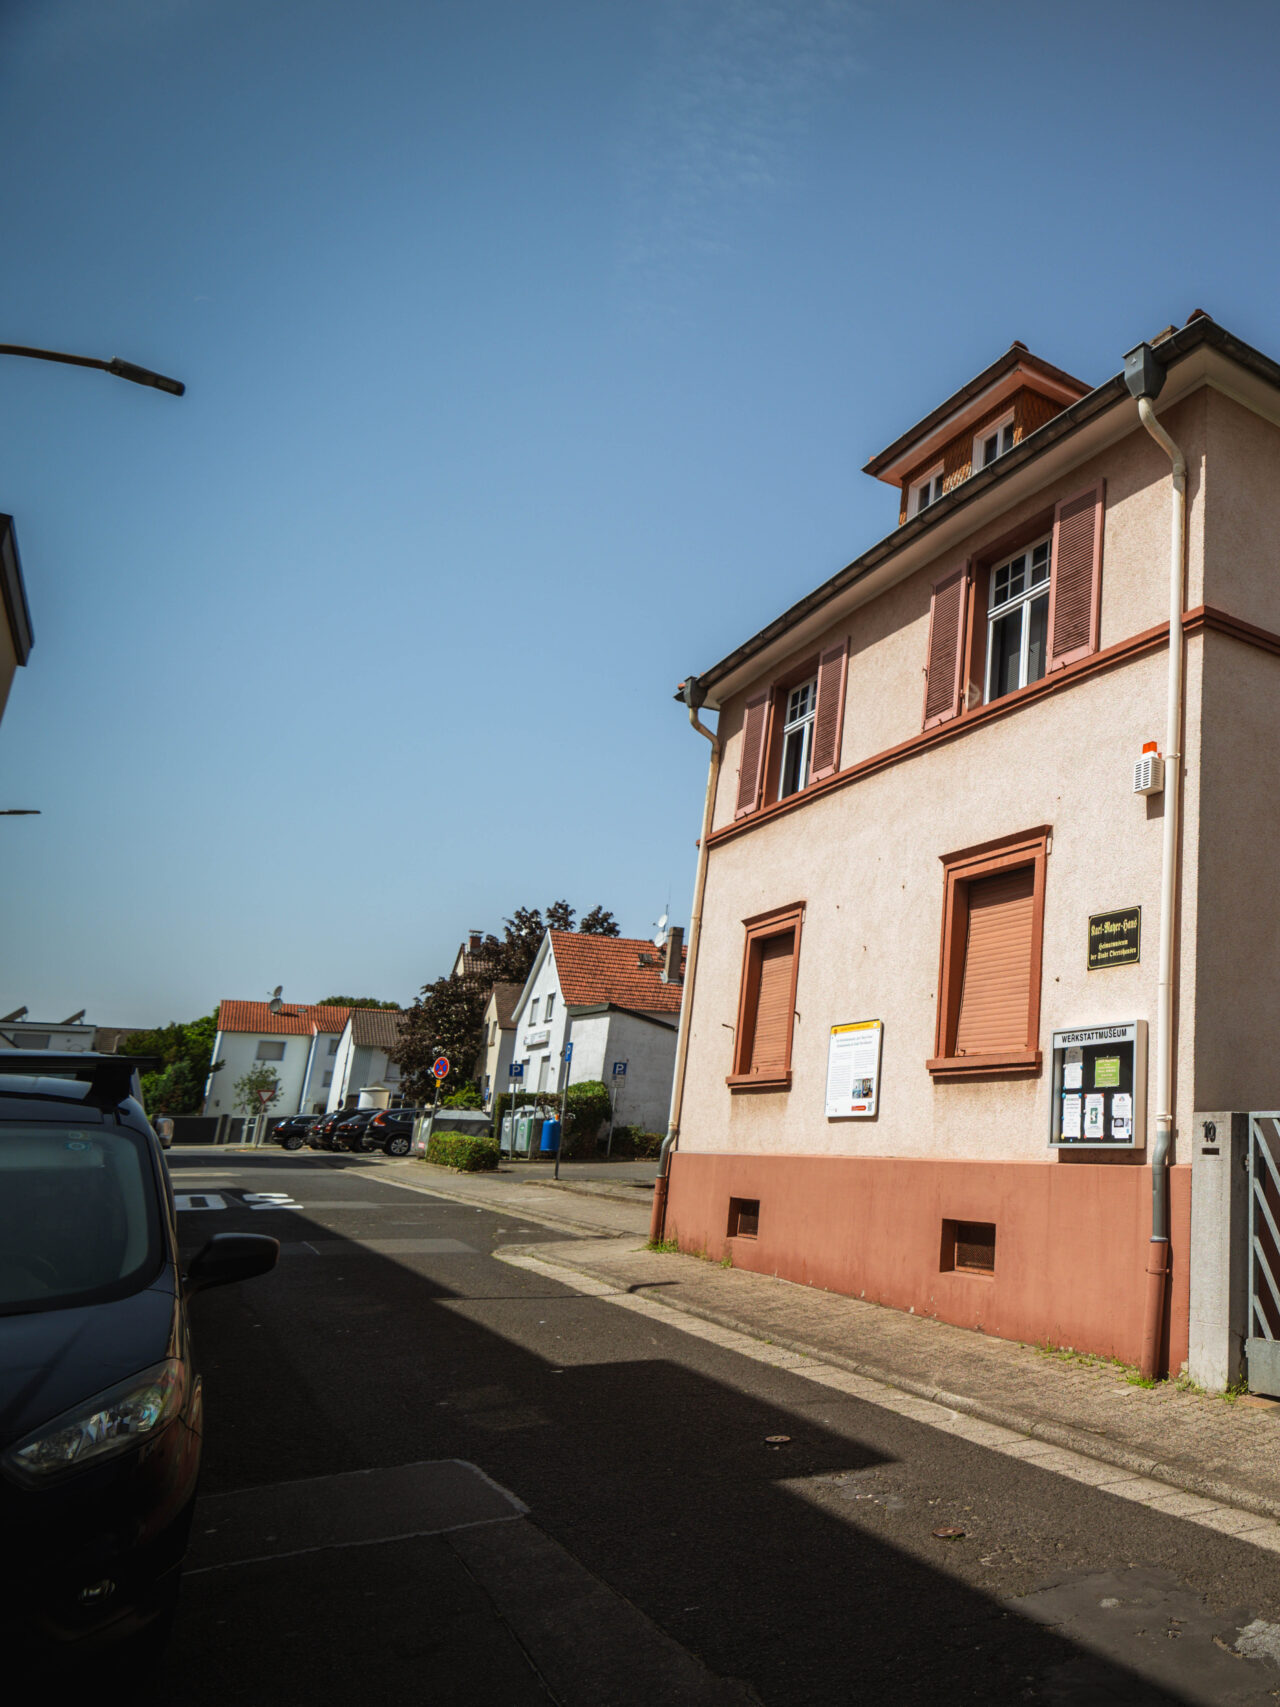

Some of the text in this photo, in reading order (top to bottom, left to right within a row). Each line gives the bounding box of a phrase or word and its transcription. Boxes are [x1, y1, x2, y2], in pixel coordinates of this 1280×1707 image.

[1061, 1028, 1127, 1043] WERKSTATTMUSEUM
[512, 1065, 521, 1076] P
[615, 1064, 624, 1075] P
[1202, 1120, 1216, 1141] 10
